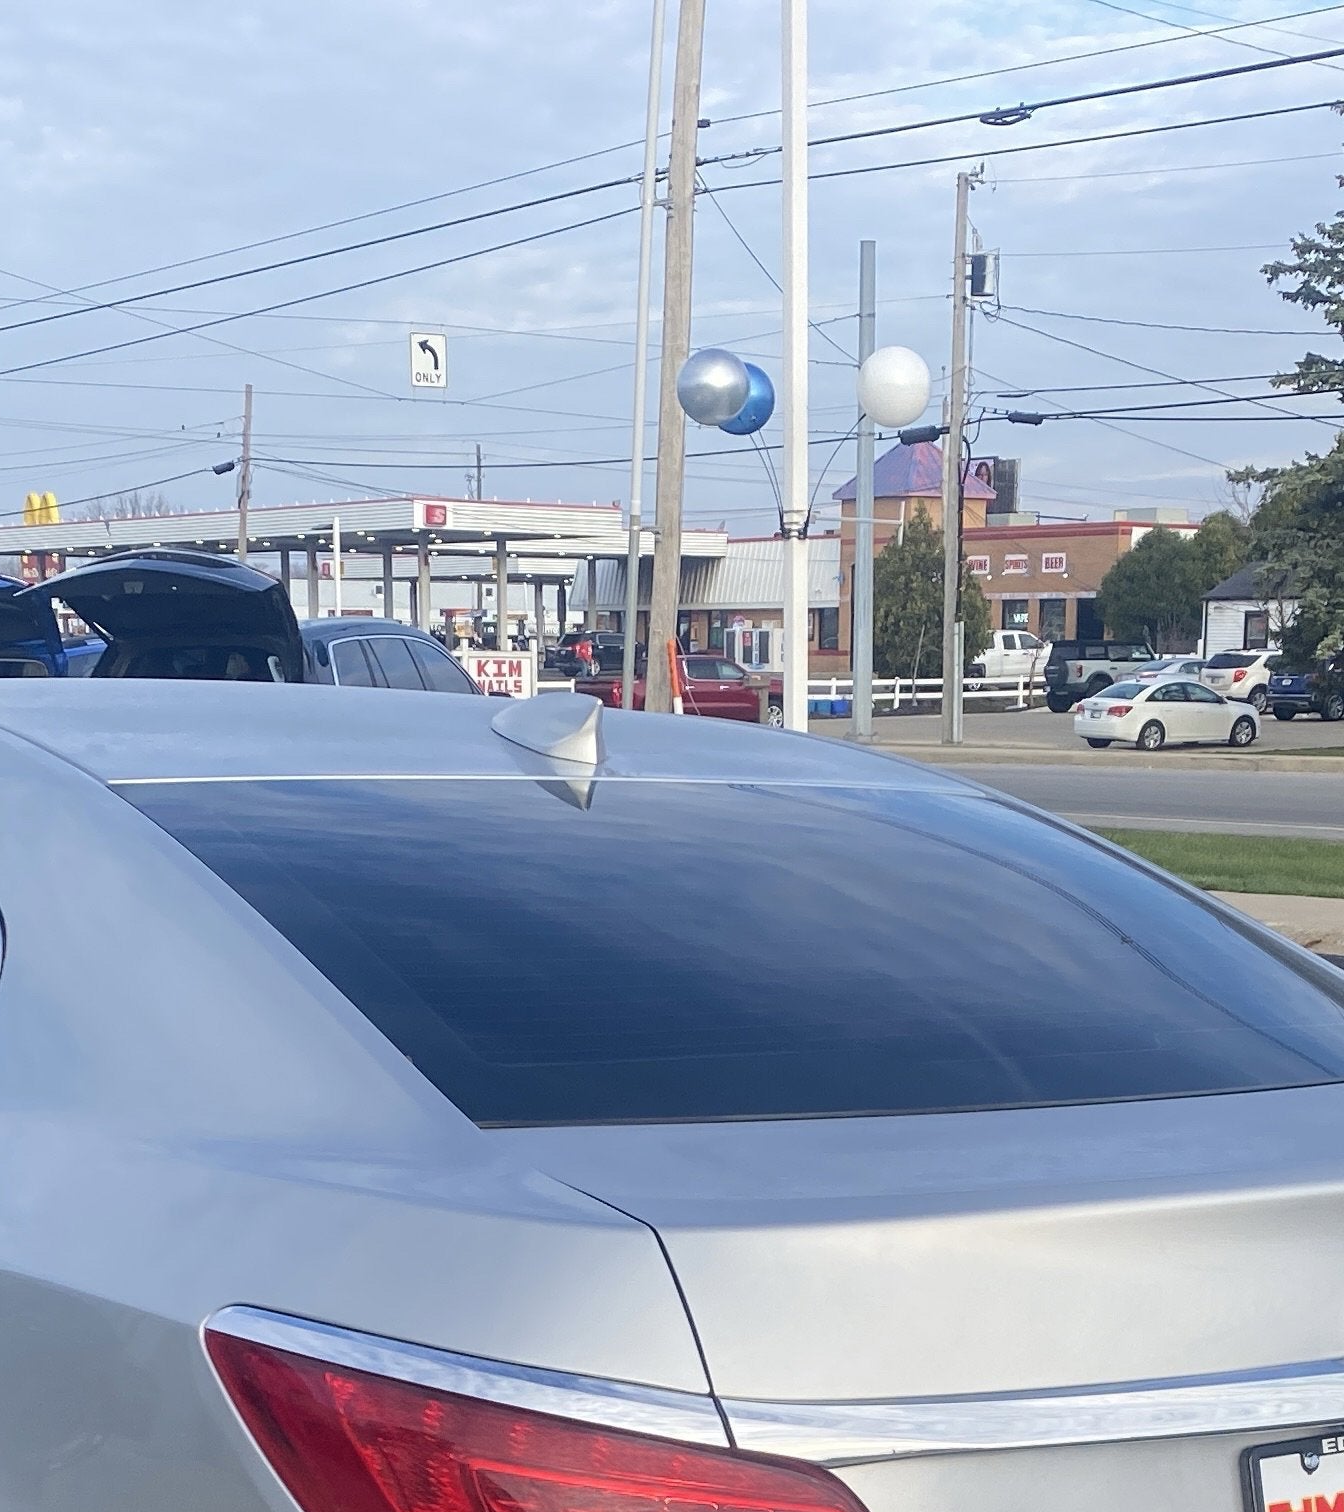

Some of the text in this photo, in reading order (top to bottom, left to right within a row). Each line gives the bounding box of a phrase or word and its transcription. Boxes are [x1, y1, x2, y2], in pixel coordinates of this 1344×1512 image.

[415, 371, 442, 384] ONLY
[1044, 556, 1064, 570] BEER
[477, 659, 523, 678] KIM
[477, 680, 523, 694] NAILS
